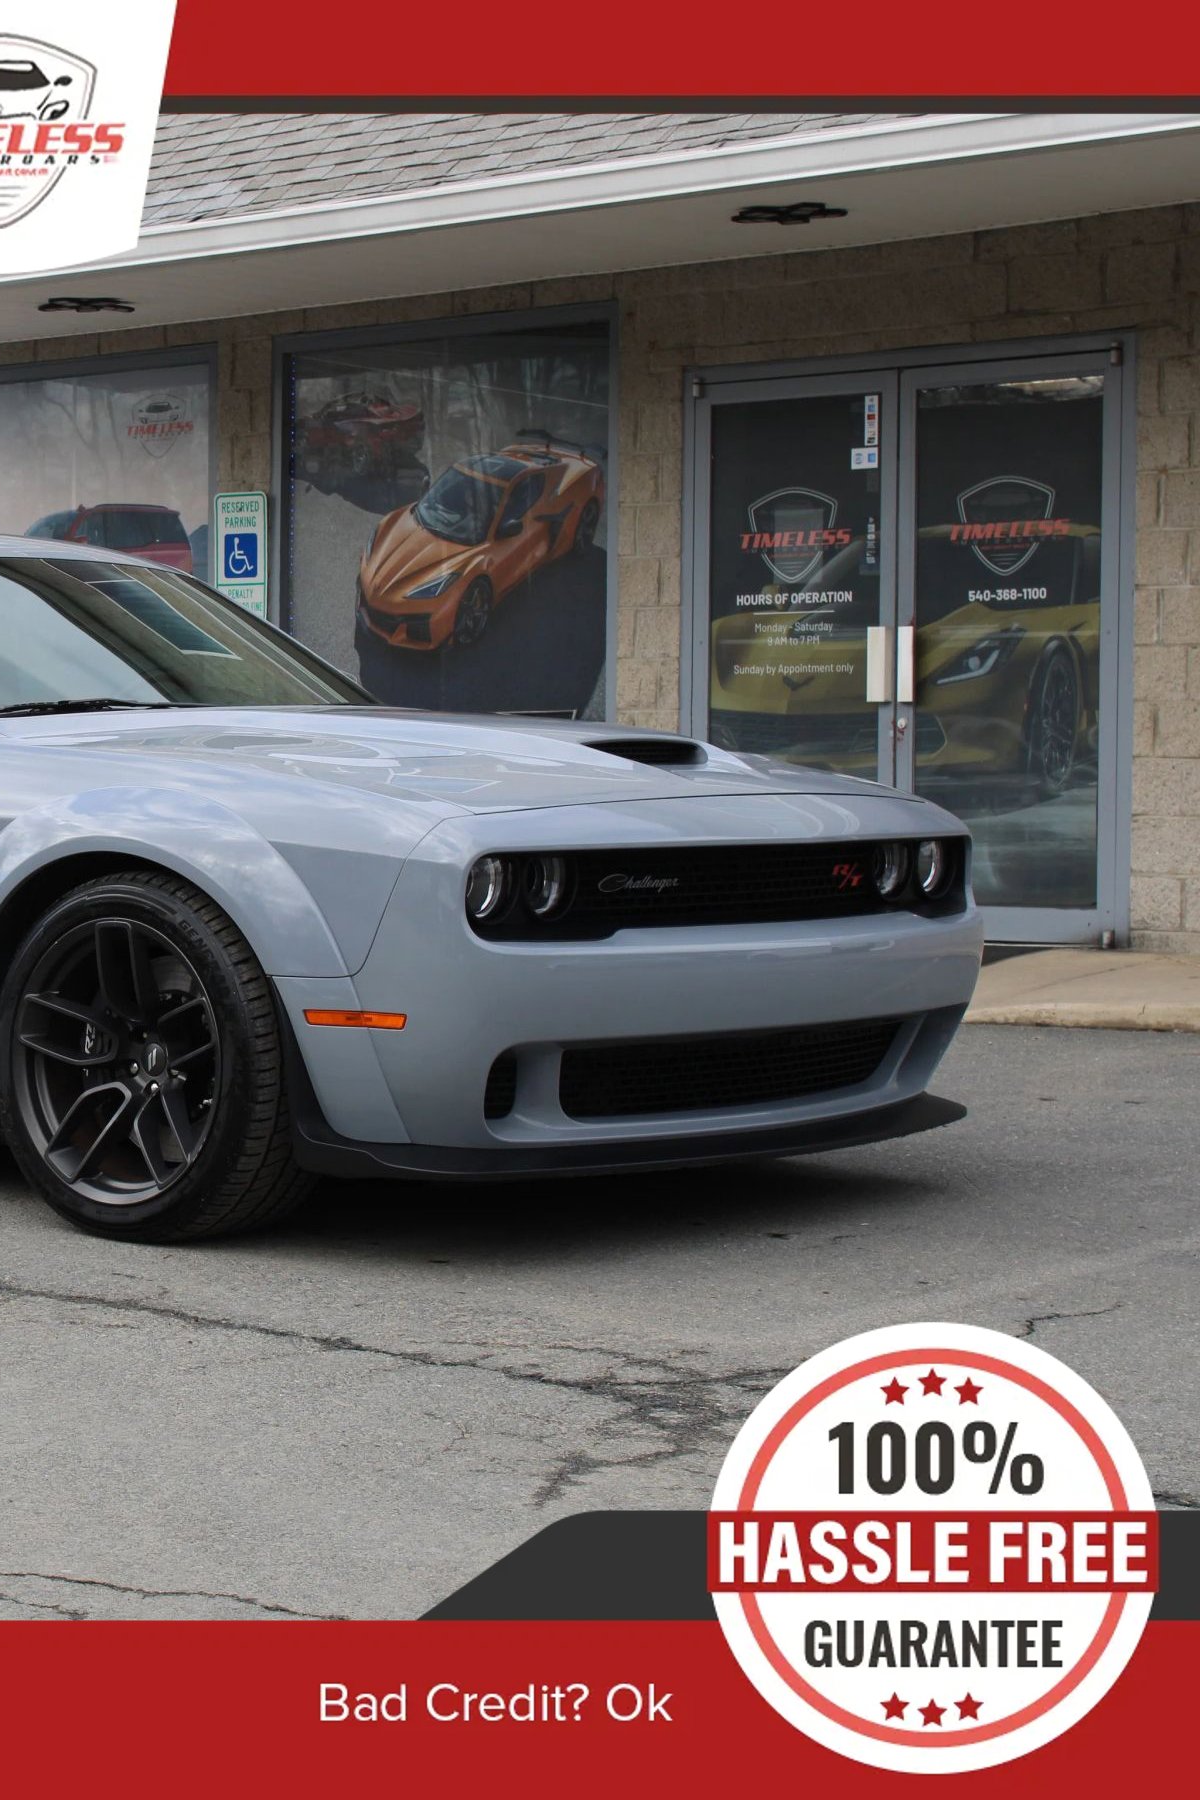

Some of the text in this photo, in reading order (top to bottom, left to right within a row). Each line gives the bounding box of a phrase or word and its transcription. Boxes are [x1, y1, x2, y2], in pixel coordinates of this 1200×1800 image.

[221, 501, 259, 513] RESERVED
[224, 516, 256, 528] PARKING
[949, 518, 1071, 542] TIMELESS
[740, 528, 852, 550] TIMELESS
[228, 588, 254, 599] PENALTY
[736, 591, 853, 606] HOURS OF OPERATION
[968, 587, 1047, 602] 540-368-1100
[754, 623, 788, 634] Monday
[794, 621, 833, 632] Saturday
[774, 636, 788, 646] AM
[789, 636, 798, 646] to
[806, 635, 820, 645] PM
[733, 663, 854, 676] Sunday by Appointment only
[598, 873, 680, 893] Challenger
[831, 861, 863, 891] R/T
